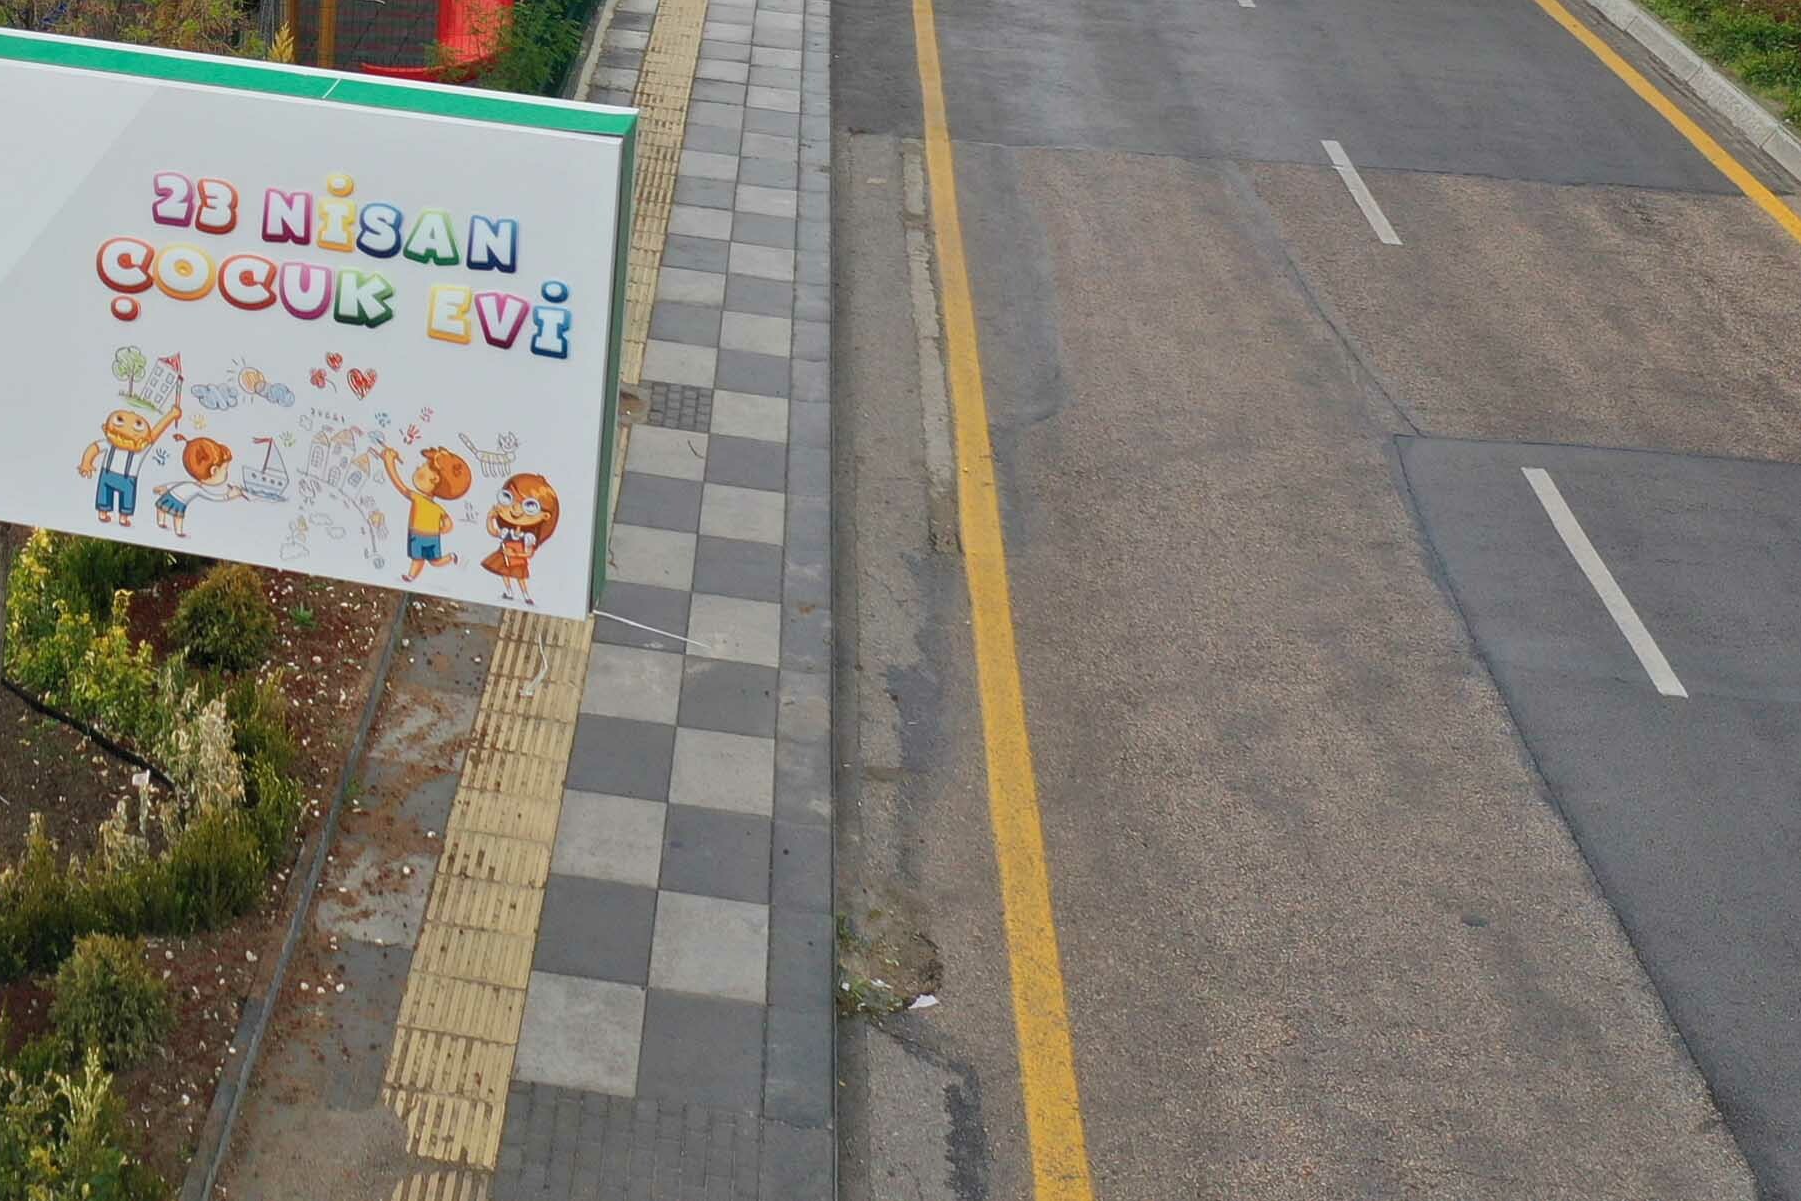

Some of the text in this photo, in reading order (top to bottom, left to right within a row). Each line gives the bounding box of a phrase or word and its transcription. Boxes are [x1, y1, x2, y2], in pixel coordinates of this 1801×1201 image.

[152, 171, 519, 274] 23 NİSAN
[96, 237, 572, 359] ÇOCUK EVİ
